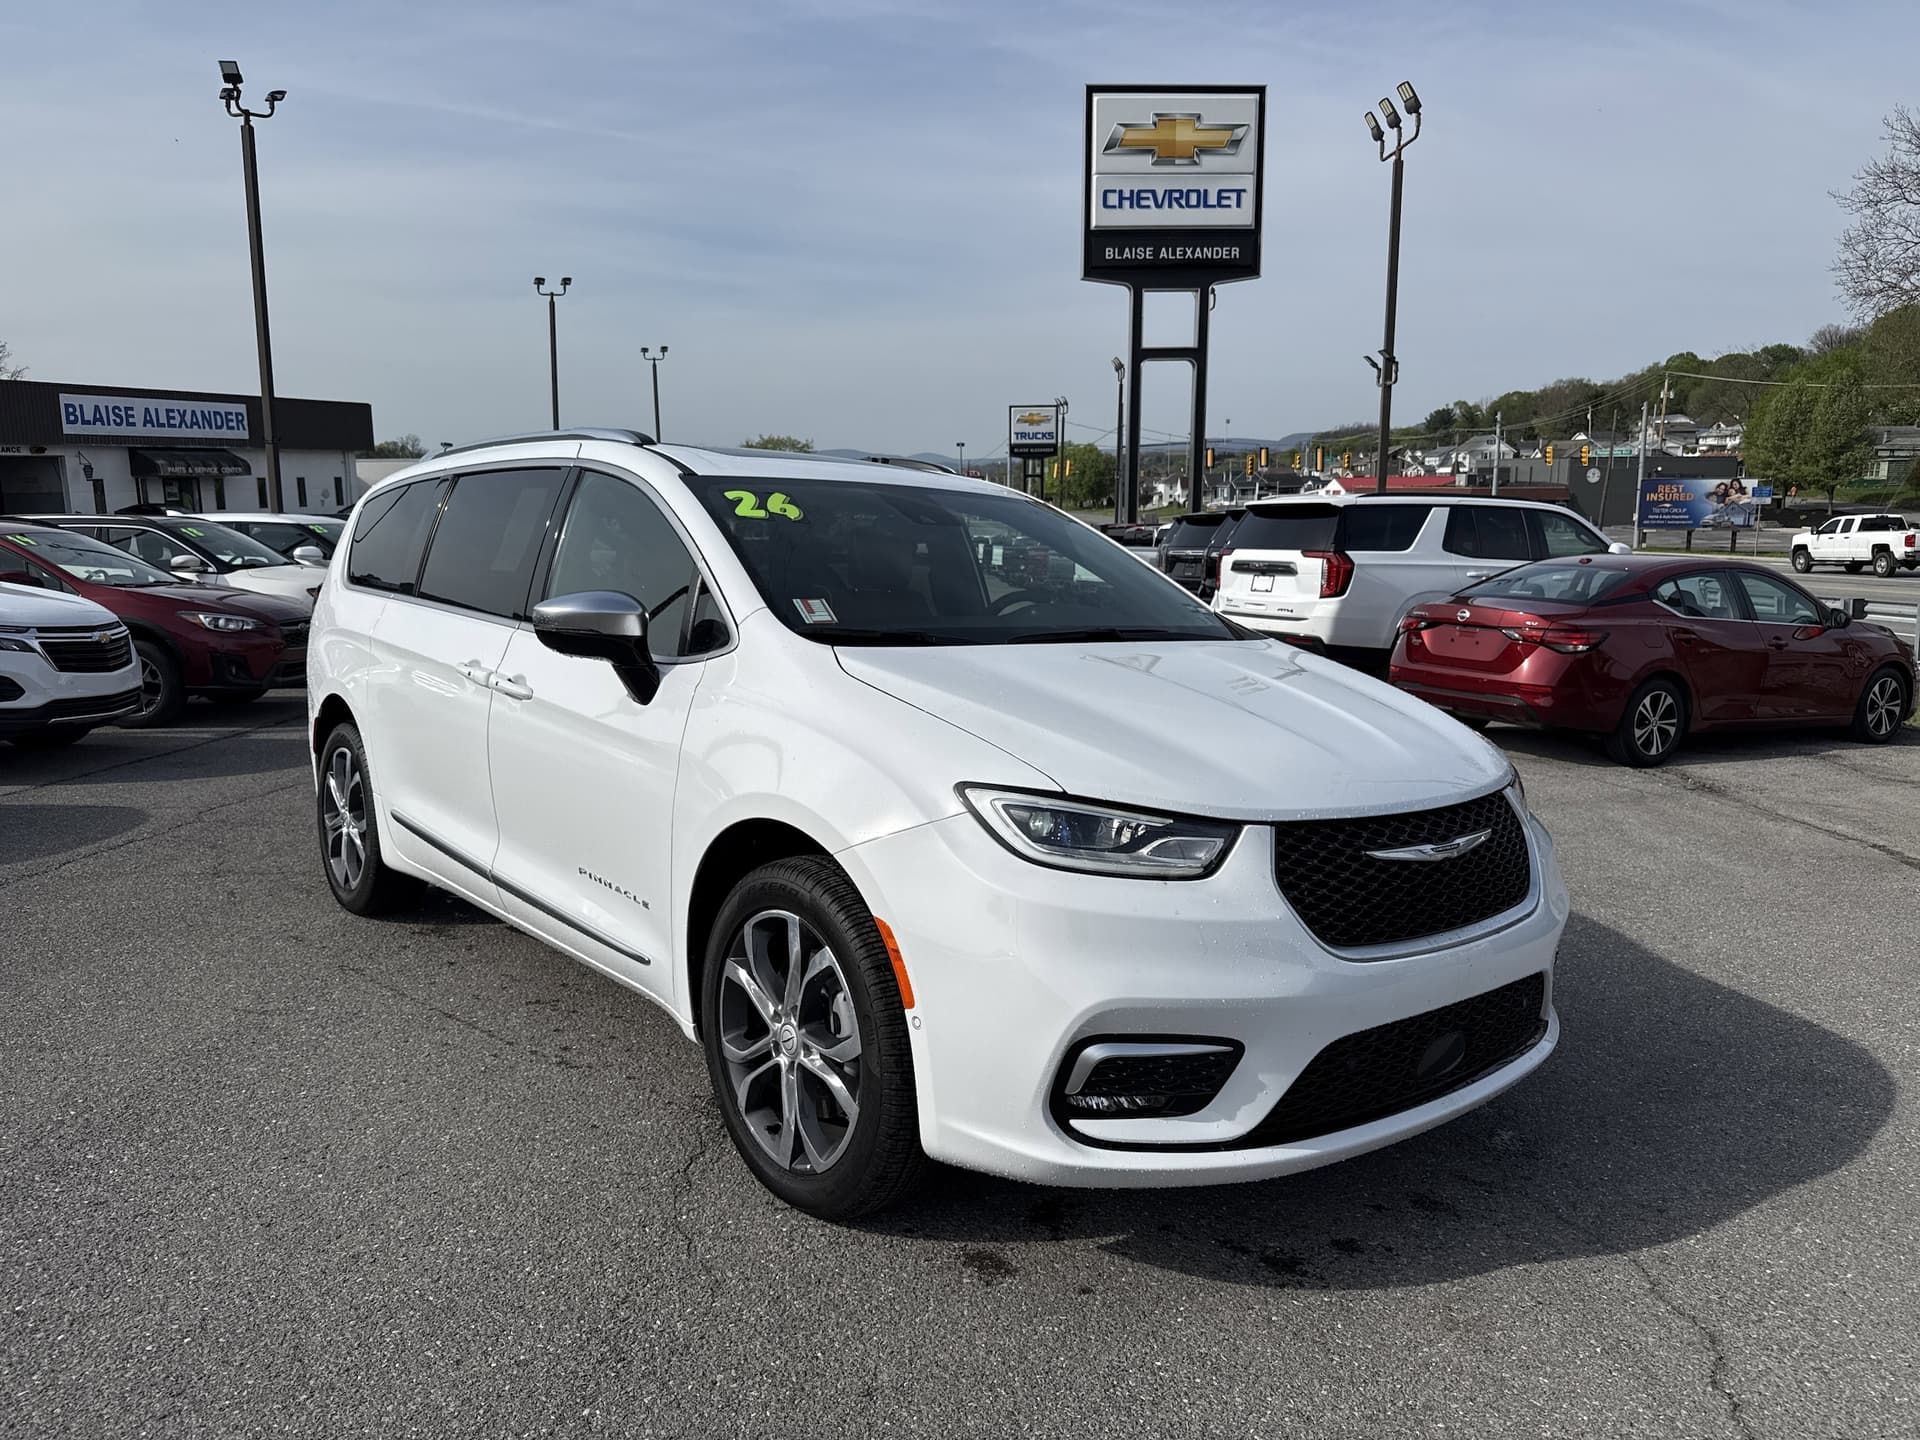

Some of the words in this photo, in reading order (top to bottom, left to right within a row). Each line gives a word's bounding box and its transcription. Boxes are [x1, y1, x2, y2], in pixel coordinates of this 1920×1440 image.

[1102, 188, 1247, 209] CHEVROLET
[1105, 247, 1154, 260] BLAISE
[1159, 247, 1240, 260] ALEXANDER
[64, 403, 137, 427] BLAISE
[143, 407, 246, 431] ALEXANDER
[1014, 431, 1054, 441] TRUCKS
[1646, 492, 1696, 502] INSURED
[1657, 484, 1685, 493] REST
[723, 490, 804, 521] 26
[578, 866, 651, 910] PINNACLE
